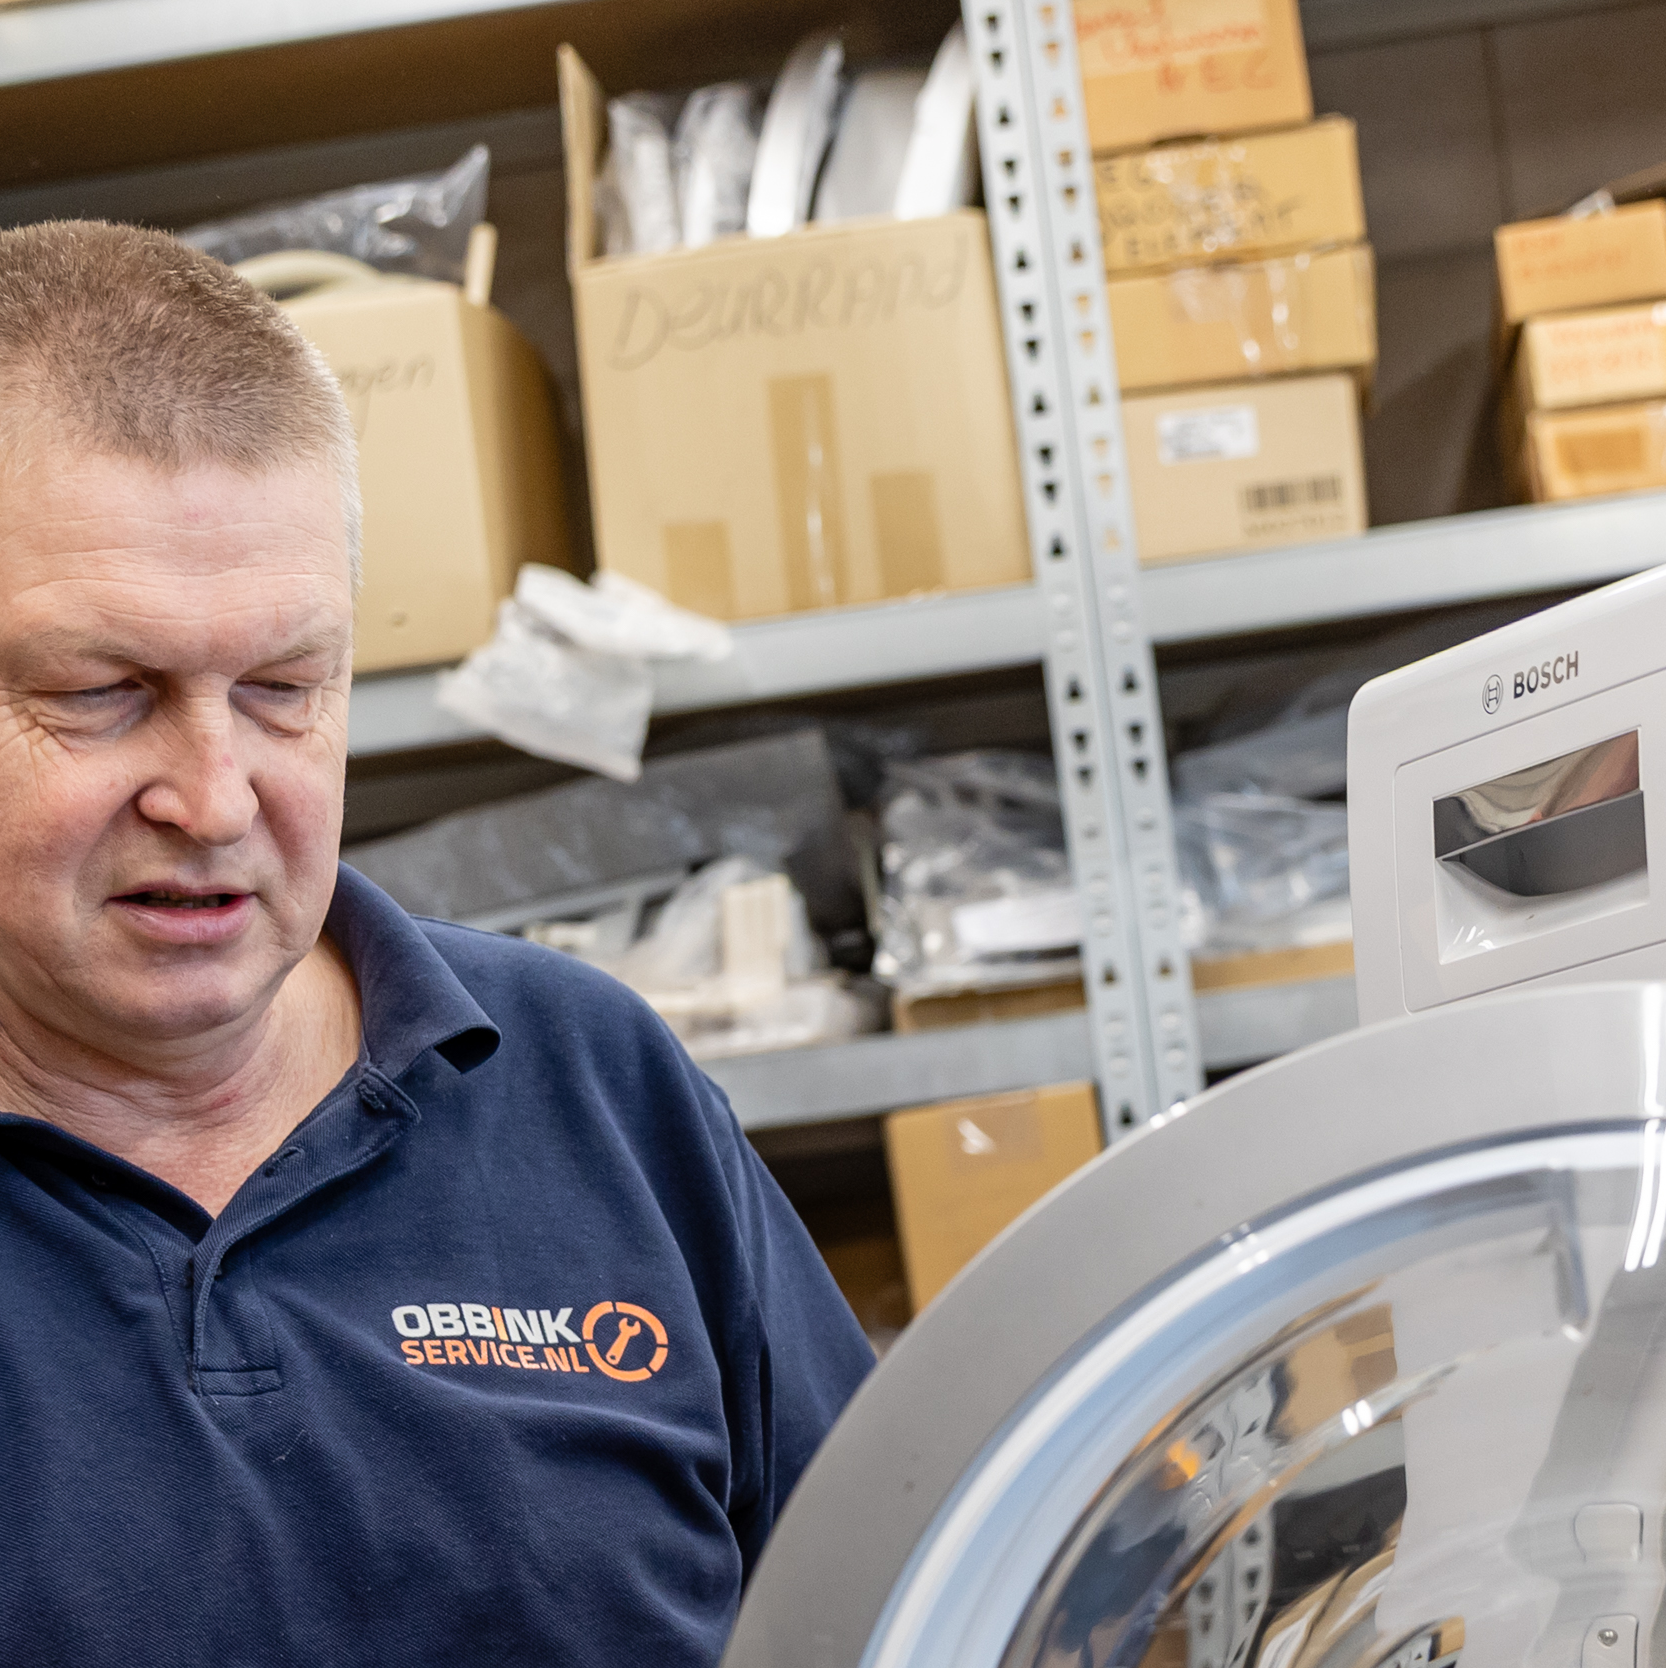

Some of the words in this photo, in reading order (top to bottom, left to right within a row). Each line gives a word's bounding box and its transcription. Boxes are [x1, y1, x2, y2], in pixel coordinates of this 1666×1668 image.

[1513, 650, 1579, 699] BOSCH
[391, 1302, 582, 1344] OBBINK
[400, 1339, 590, 1374] SERVICE.NL
